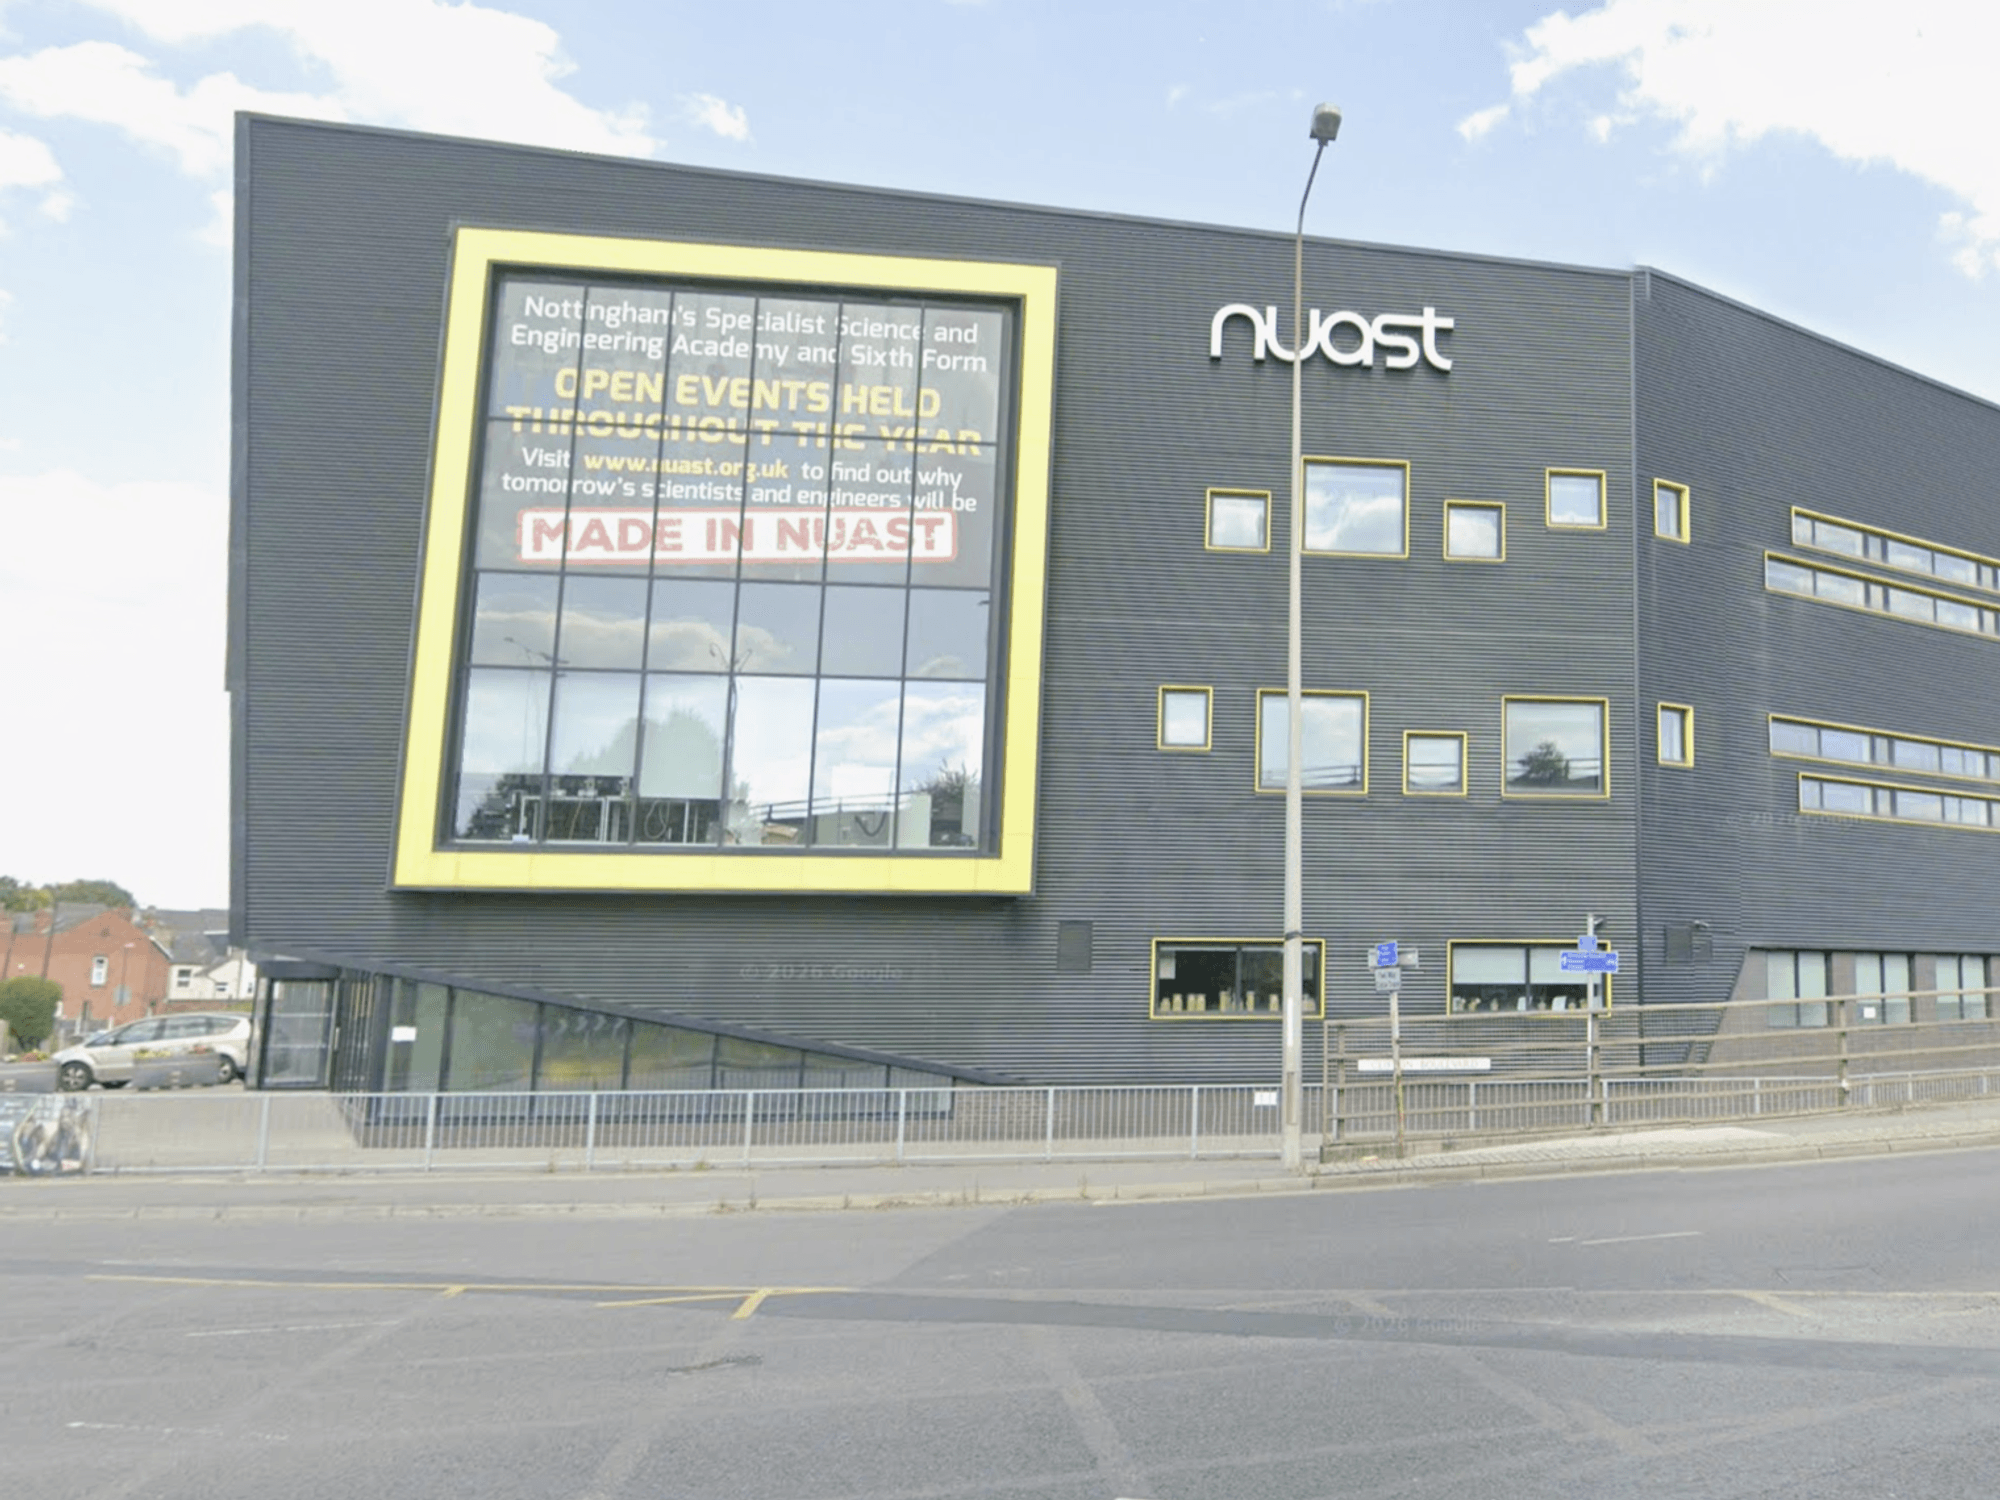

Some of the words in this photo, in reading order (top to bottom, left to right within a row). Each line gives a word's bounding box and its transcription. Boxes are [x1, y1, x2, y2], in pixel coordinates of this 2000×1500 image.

[524, 296, 696, 328] Nottngham's
[834, 315, 927, 341] Science
[933, 322, 979, 344] and
[1210, 303, 1455, 371] nuast
[511, 324, 665, 360] Engineering
[671, 333, 789, 367] Academy
[797, 342, 843, 365] and
[850, 344, 914, 369] Sixth
[921, 348, 987, 372] Form
[555, 367, 665, 403] OPEN
[675, 374, 830, 413] EVENTS
[841, 383, 941, 418] HELD
[505, 405, 779, 446] THROUGHOUT
[792, 420, 867, 450] THE
[879, 424, 982, 456] YEAR
[522, 447, 572, 469] Visit
[583, 454, 789, 483] www.nuast.org.uk
[801, 462, 824, 480] to
[832, 461, 871, 482] find
[876, 466, 912, 484] out
[918, 467, 963, 491] why
[751, 484, 792, 503] and
[907, 490, 944, 510] will
[952, 493, 977, 512] be
[531, 518, 684, 552] MADE
[706, 518, 755, 552] IN
[776, 517, 945, 552] NUAST
